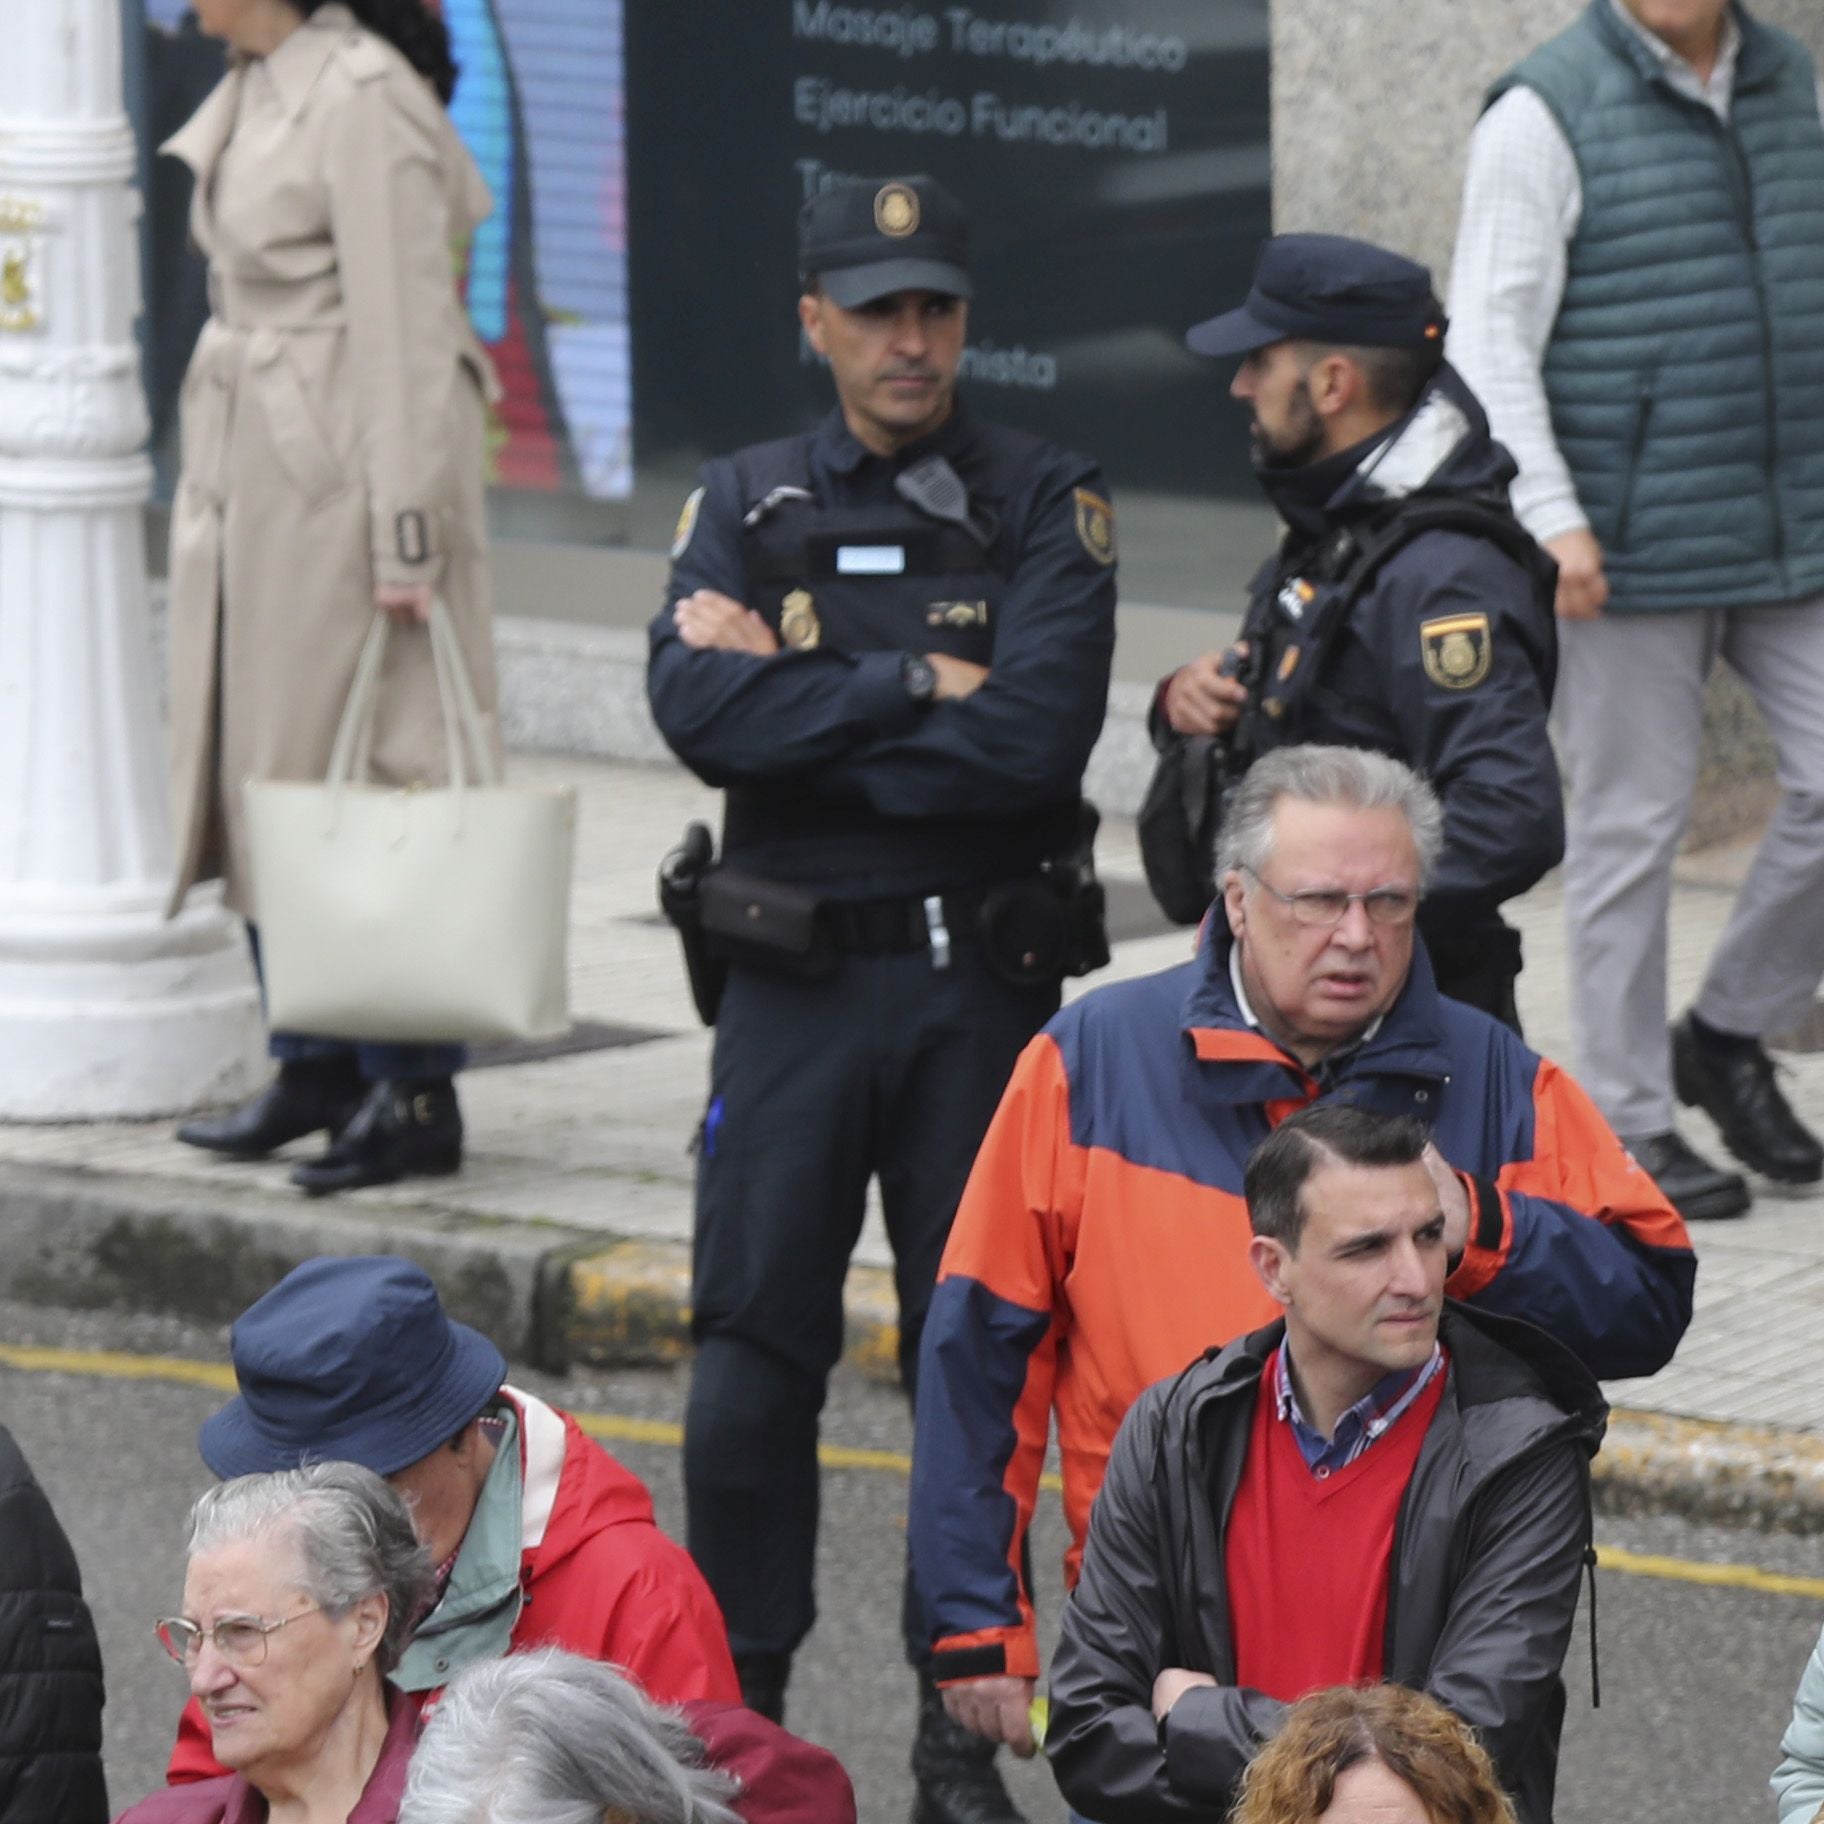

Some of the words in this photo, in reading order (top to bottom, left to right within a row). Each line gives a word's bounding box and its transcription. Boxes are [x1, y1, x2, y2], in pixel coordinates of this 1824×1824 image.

[794, 0, 938, 58] Masaje
[946, 6, 1188, 72] Terapéutico
[794, 77, 966, 134] Ejercicio
[971, 92, 1168, 151] Funcional
